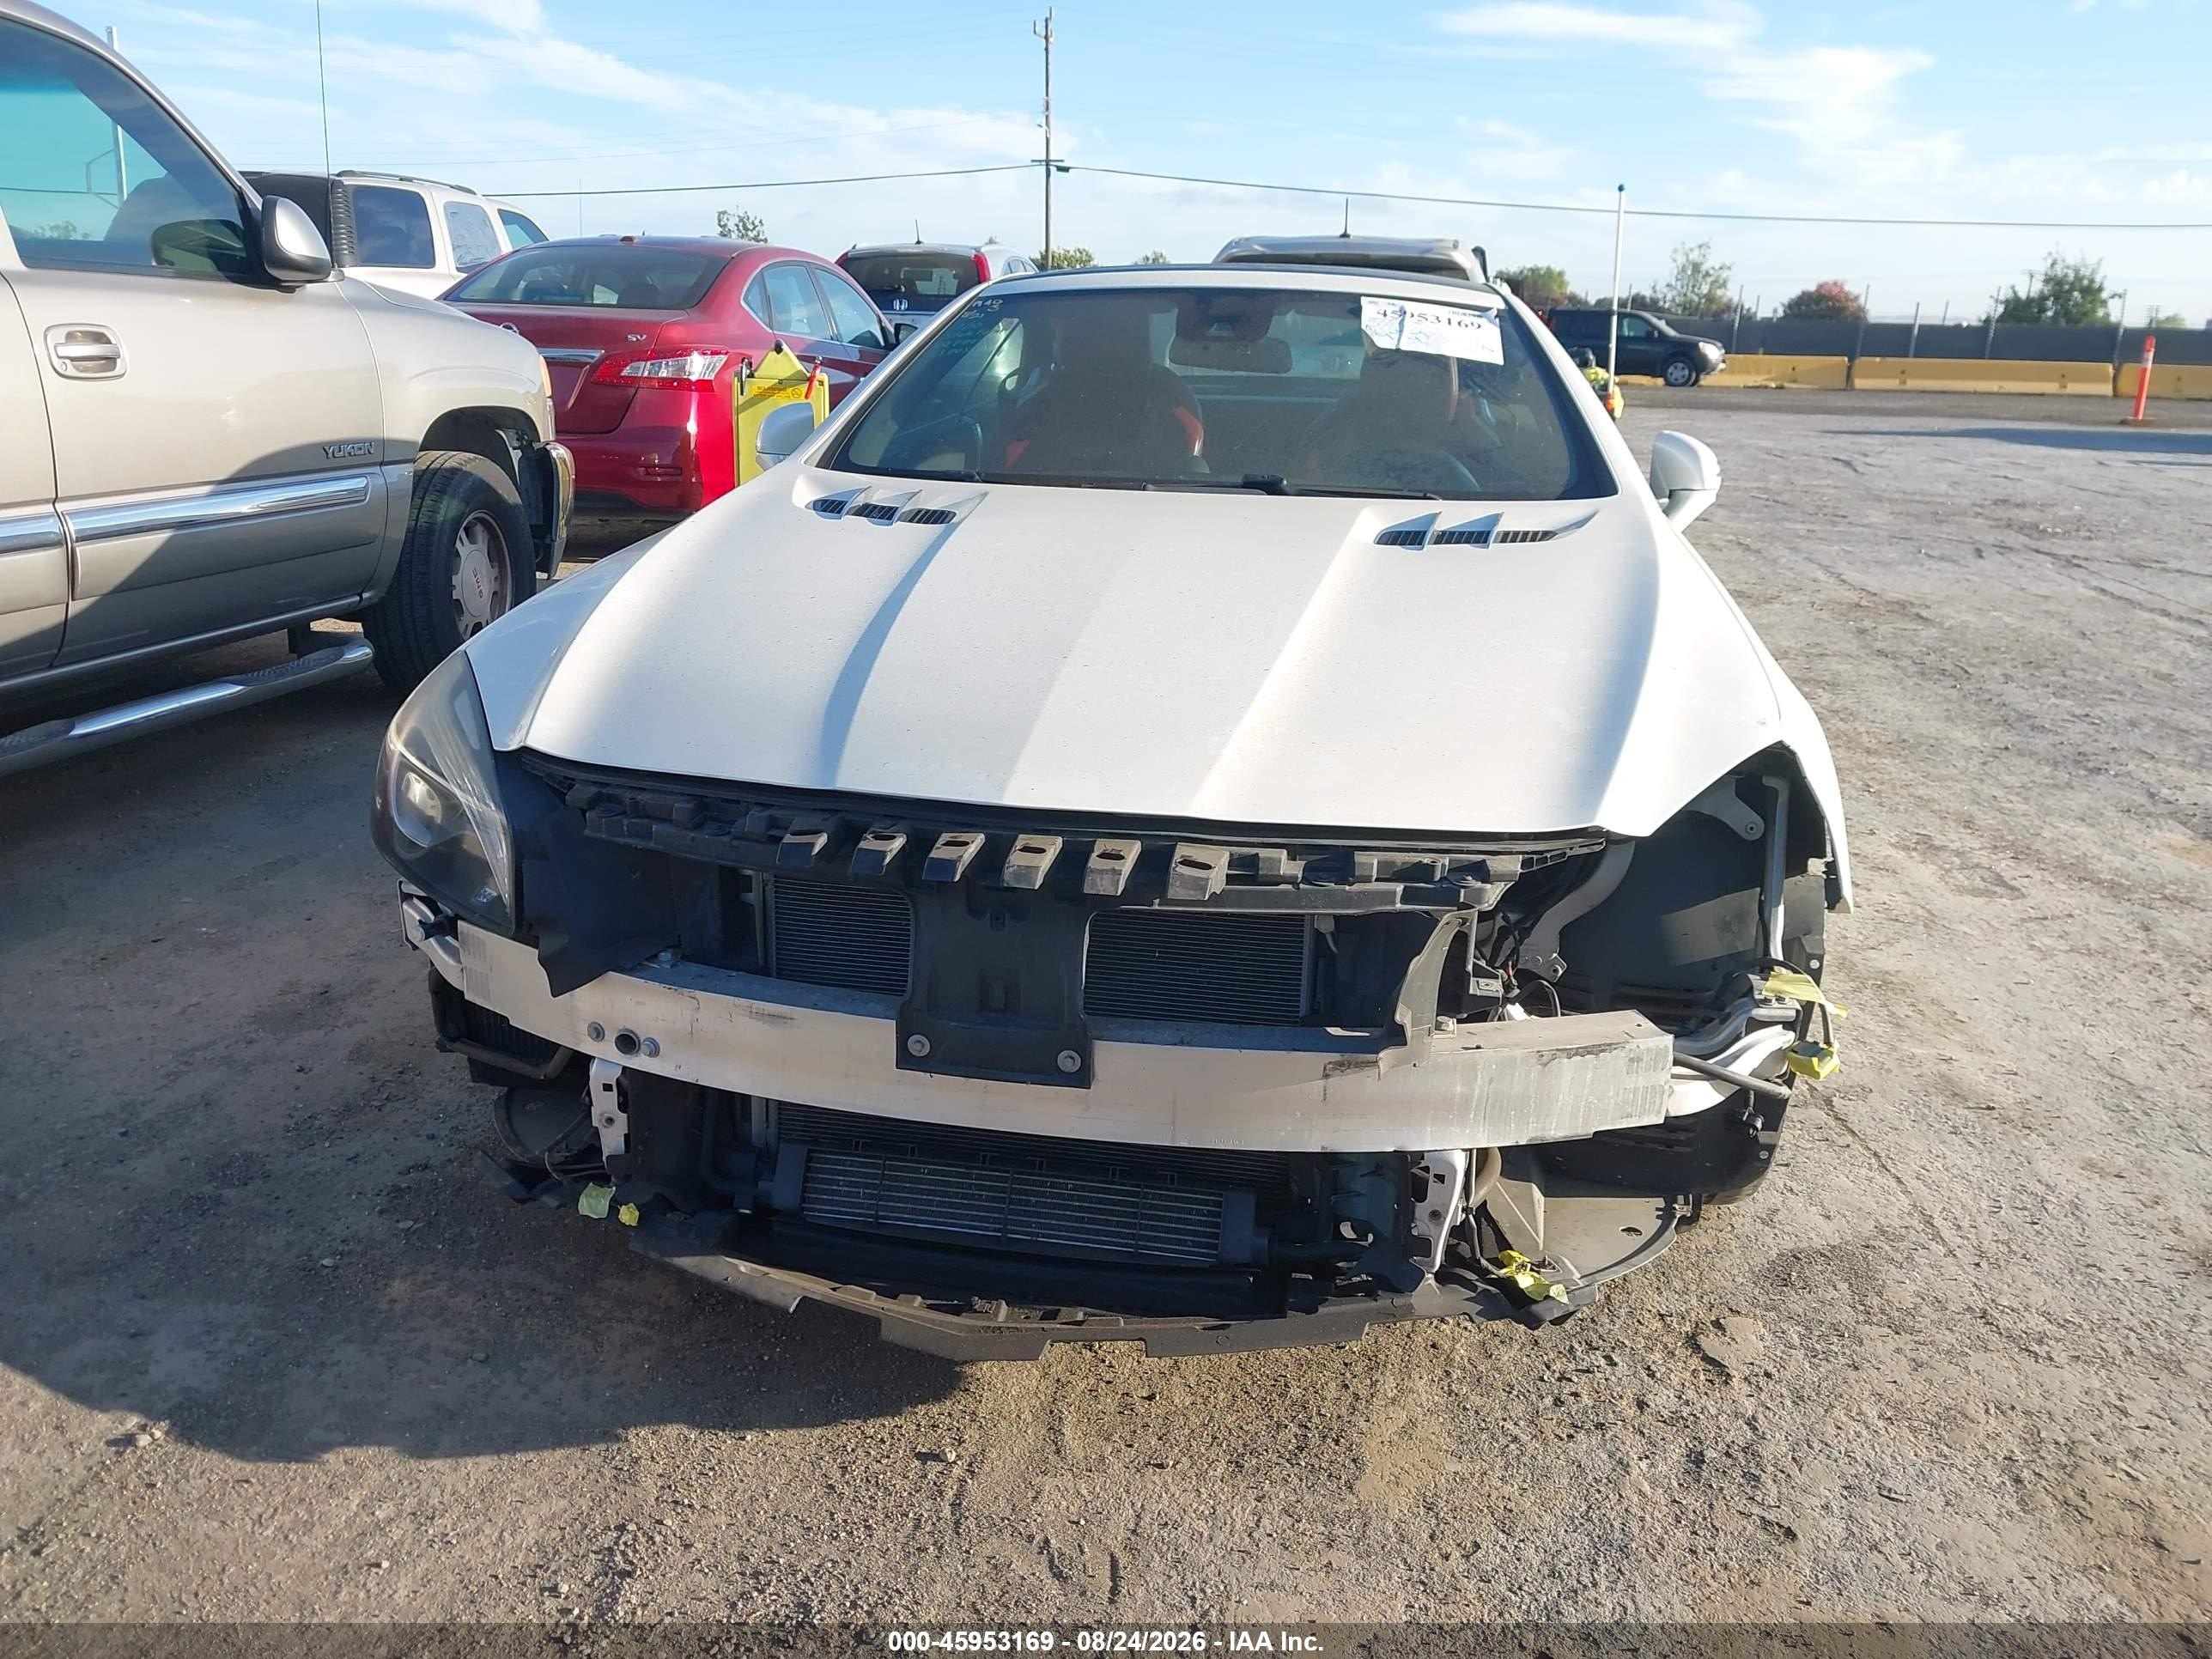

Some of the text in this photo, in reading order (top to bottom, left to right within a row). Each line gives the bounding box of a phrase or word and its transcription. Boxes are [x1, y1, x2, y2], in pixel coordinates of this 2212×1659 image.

[627, 333, 647, 342] SV
[322, 441, 375, 459] YUKON
[471, 567, 483, 599] GMC
